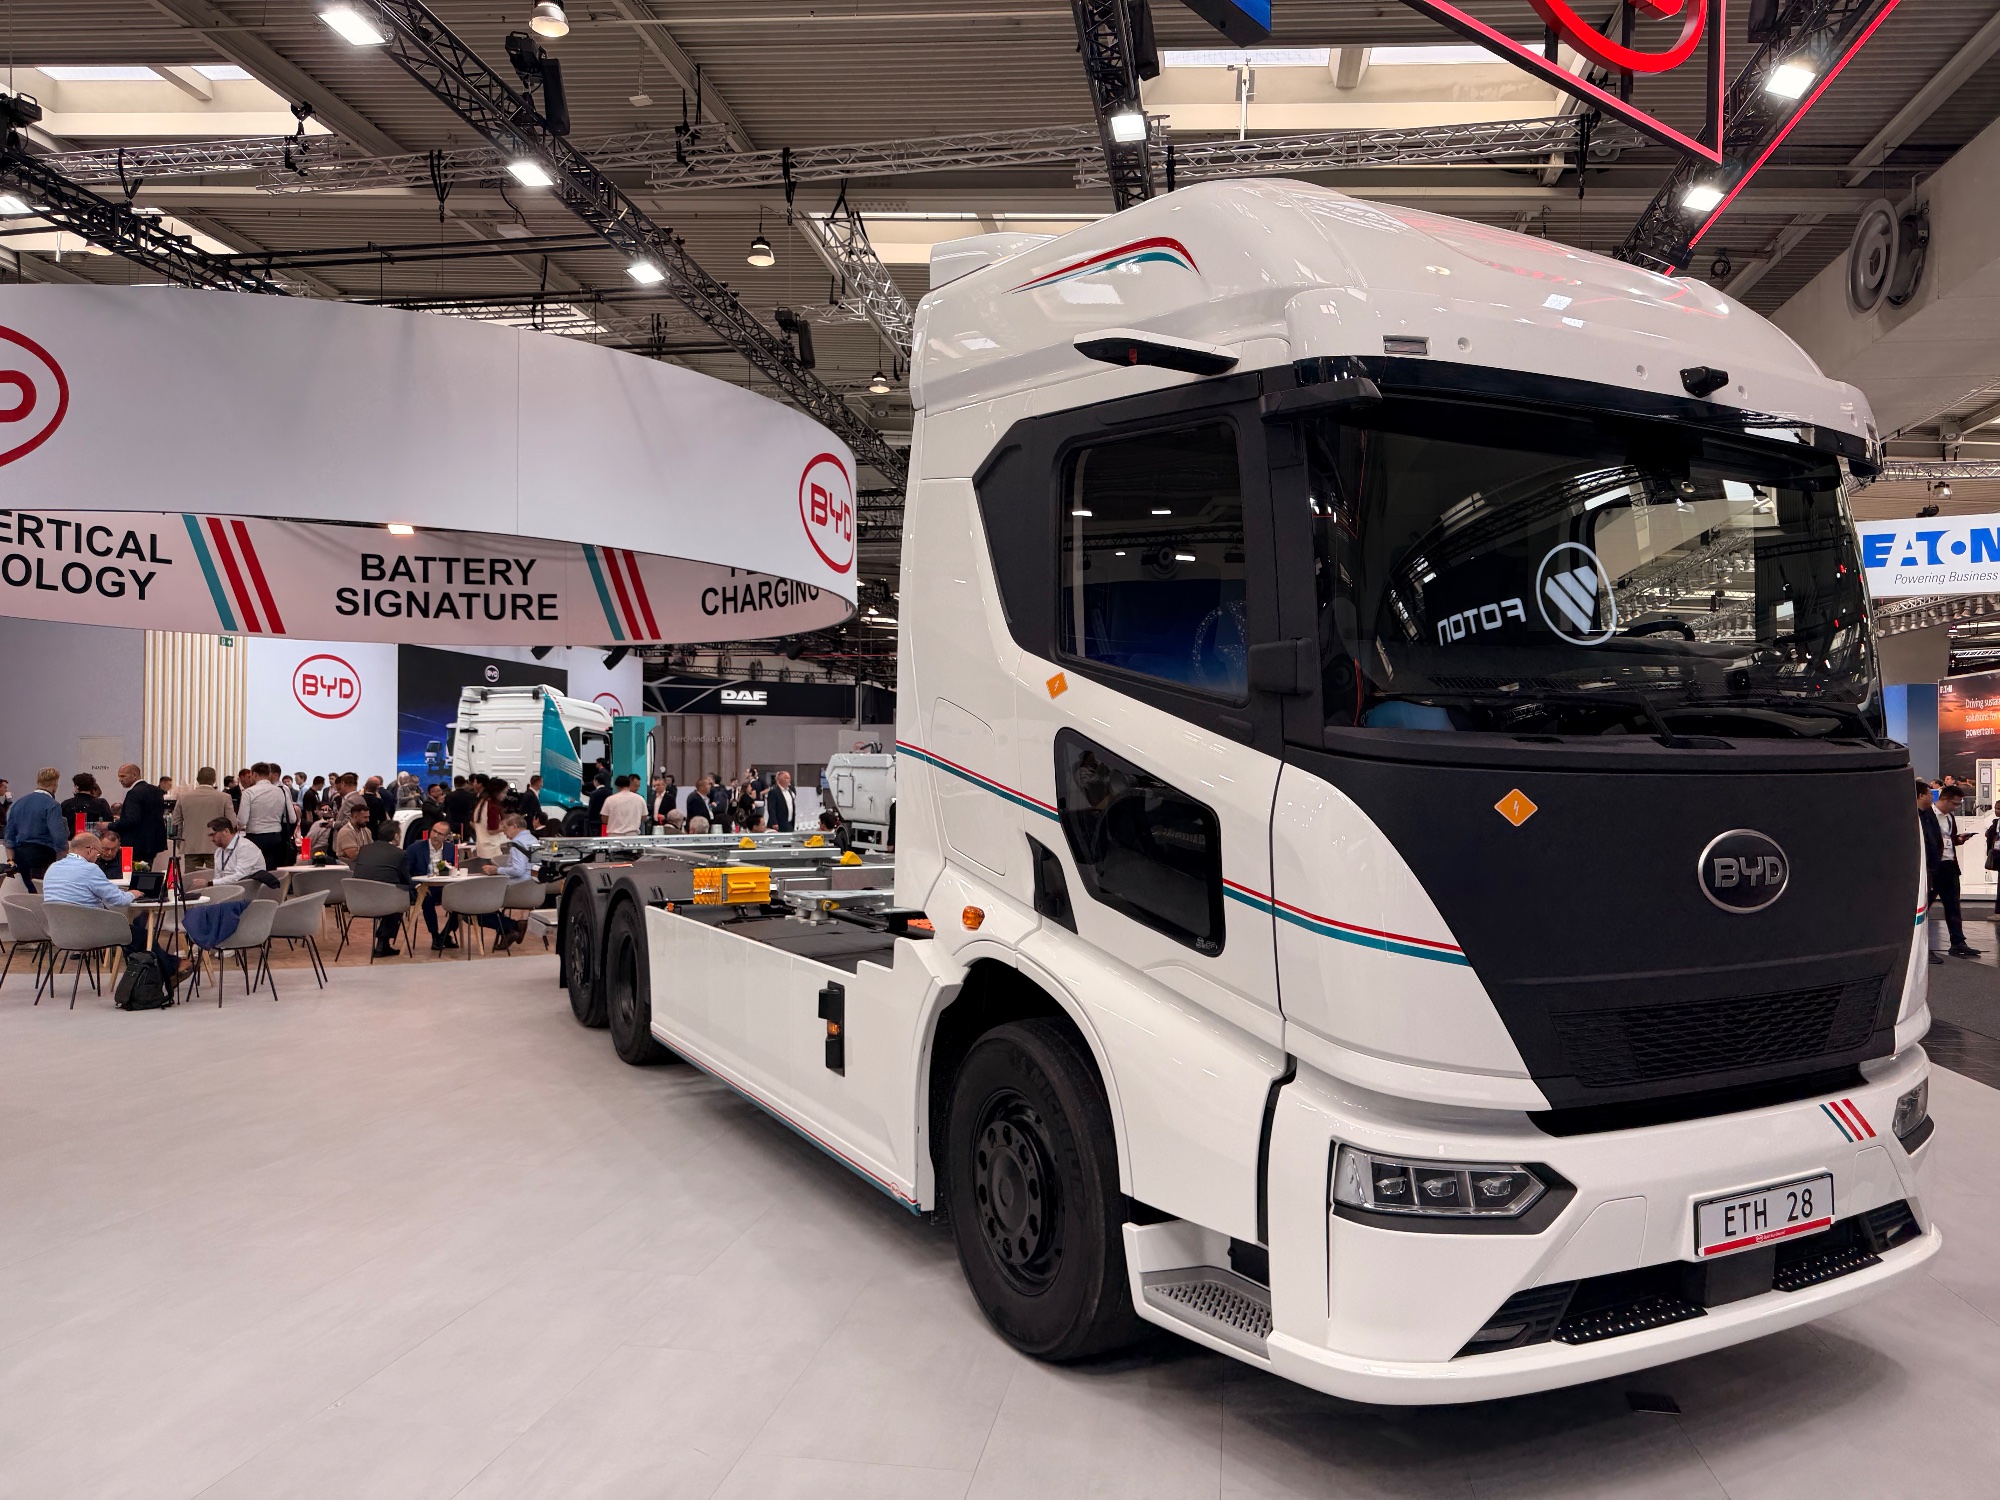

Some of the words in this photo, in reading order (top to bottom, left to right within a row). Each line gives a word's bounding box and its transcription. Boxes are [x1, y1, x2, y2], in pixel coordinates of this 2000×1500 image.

[810, 482, 852, 543] BYD
[361, 553, 537, 586] BATTERY
[1894, 572, 1946, 585] Powering
[1948, 570, 1999, 582] Business
[335, 587, 559, 621] SIGNATURE
[302, 673, 354, 699] BYD
[721, 690, 768, 700] DAF
[1965, 698, 1984, 710] Driving
[669, 735, 715, 743] Merchandise
[717, 735, 736, 743] store
[1714, 856, 1783, 888] BYD
[1724, 1197, 1768, 1237] ETH
[1786, 1188, 1813, 1222] 28
